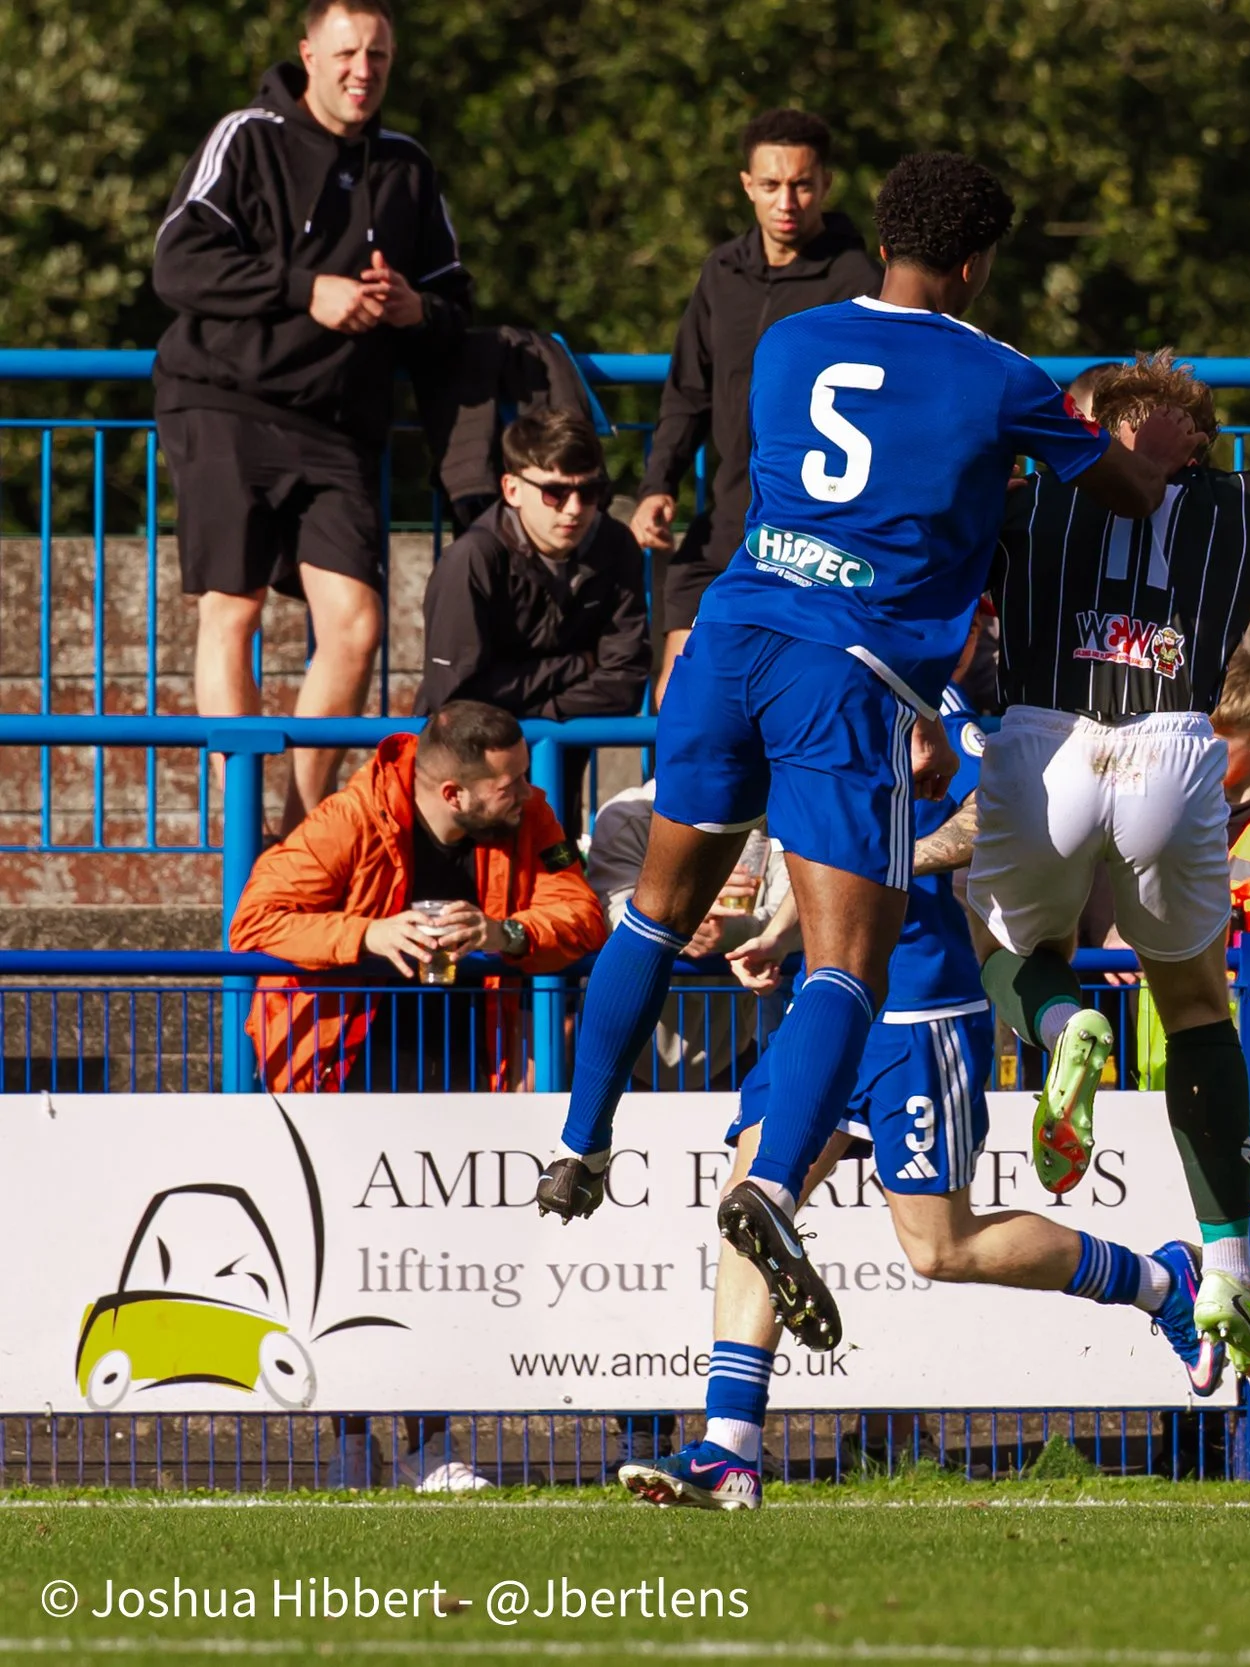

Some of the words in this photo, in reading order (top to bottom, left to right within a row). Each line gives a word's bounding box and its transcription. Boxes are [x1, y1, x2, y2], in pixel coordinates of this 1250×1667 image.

[801, 362, 886, 504] 5
[905, 1095, 935, 1152] 3
[353, 1149, 650, 1208] AMDC
[357, 1246, 524, 1308] lifting
[546, 1261, 675, 1308] your
[510, 1346, 848, 1377] www.amdeo.uk
